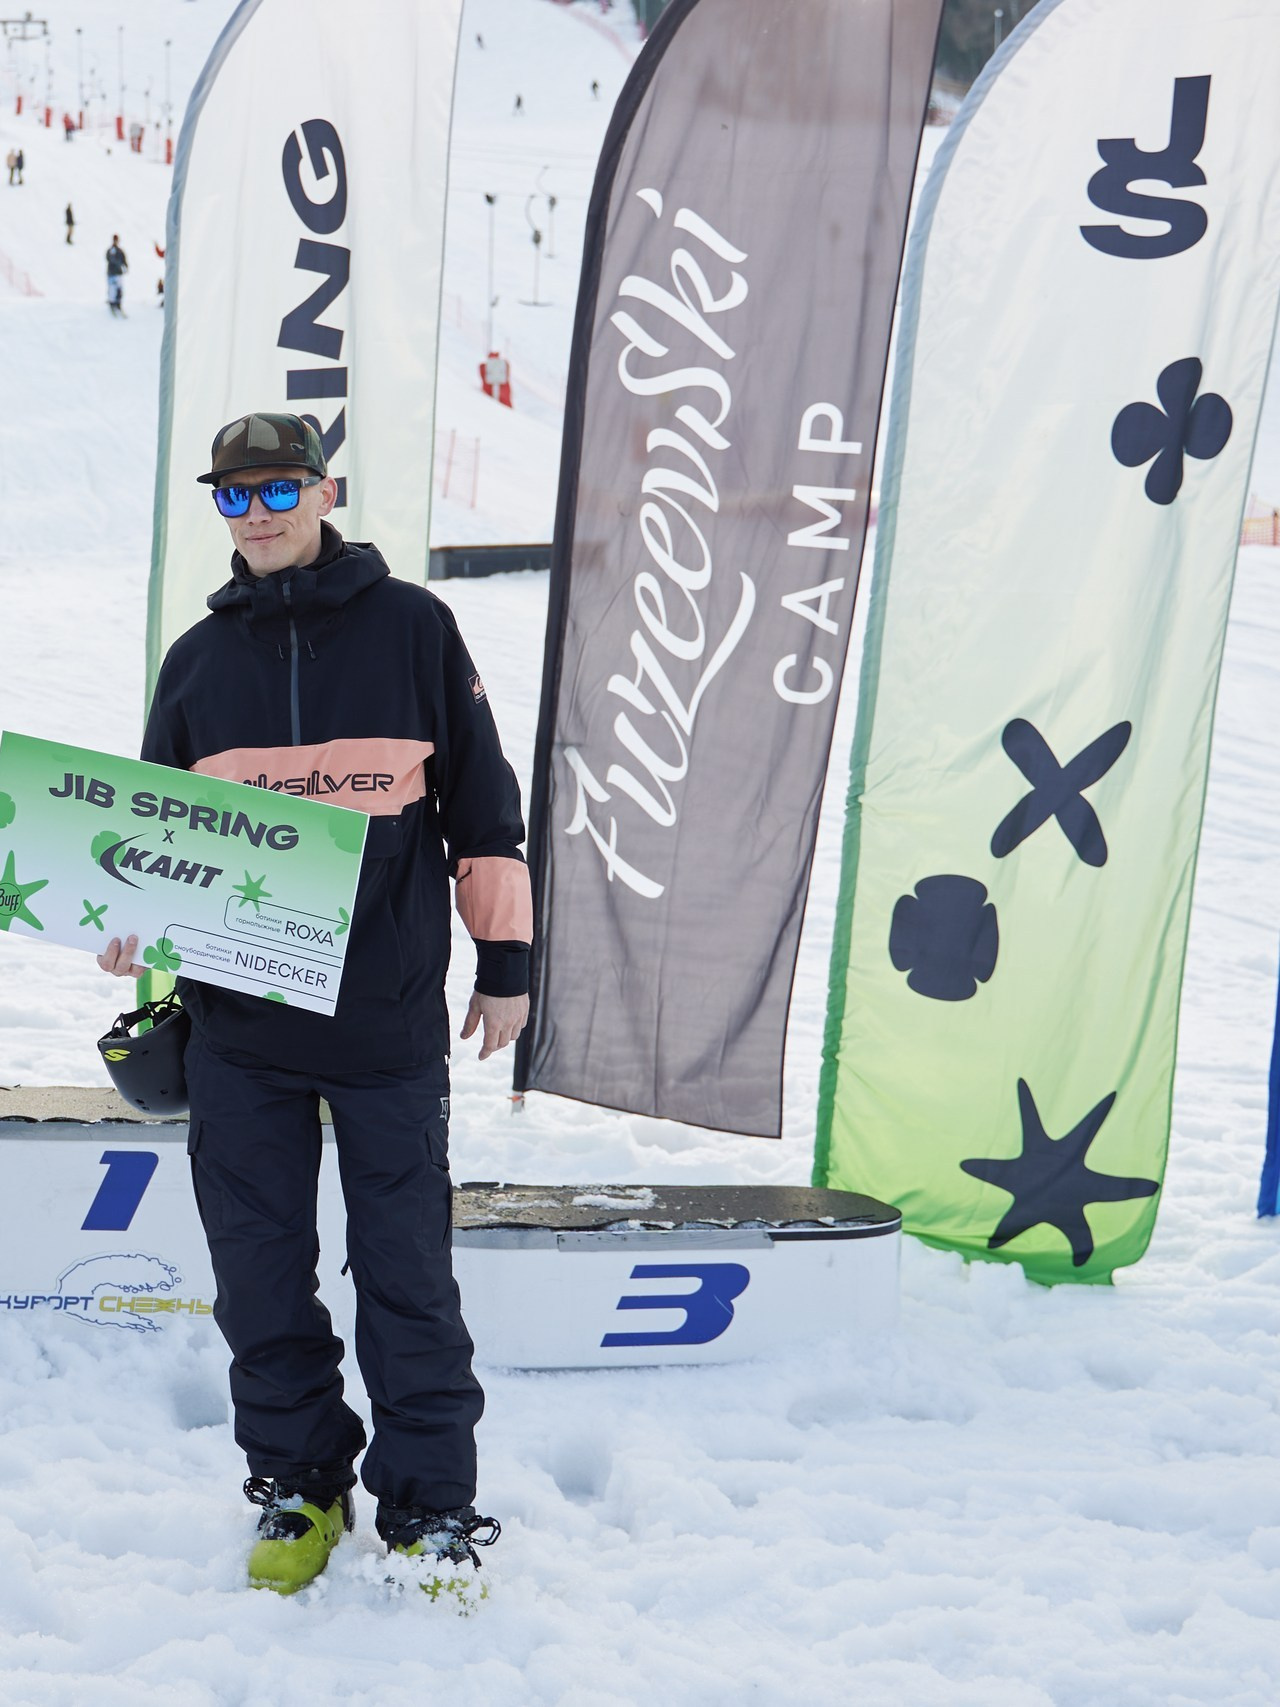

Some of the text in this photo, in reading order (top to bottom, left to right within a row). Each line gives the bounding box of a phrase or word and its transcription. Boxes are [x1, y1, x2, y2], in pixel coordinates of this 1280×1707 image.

[772, 401, 863, 705] CAMP
[48, 773, 300, 851] JIB SPRING
[235, 917, 281, 933] горнолыжные
[255, 913, 282, 924] ботинки
[284, 920, 334, 947] ROXA
[174, 944, 231, 964] сноубордические
[205, 943, 232, 955] ботинки
[234, 951, 328, 989] NIDECKER
[81, 1150, 159, 1231] 1
[600, 1262, 751, 1348] 3
